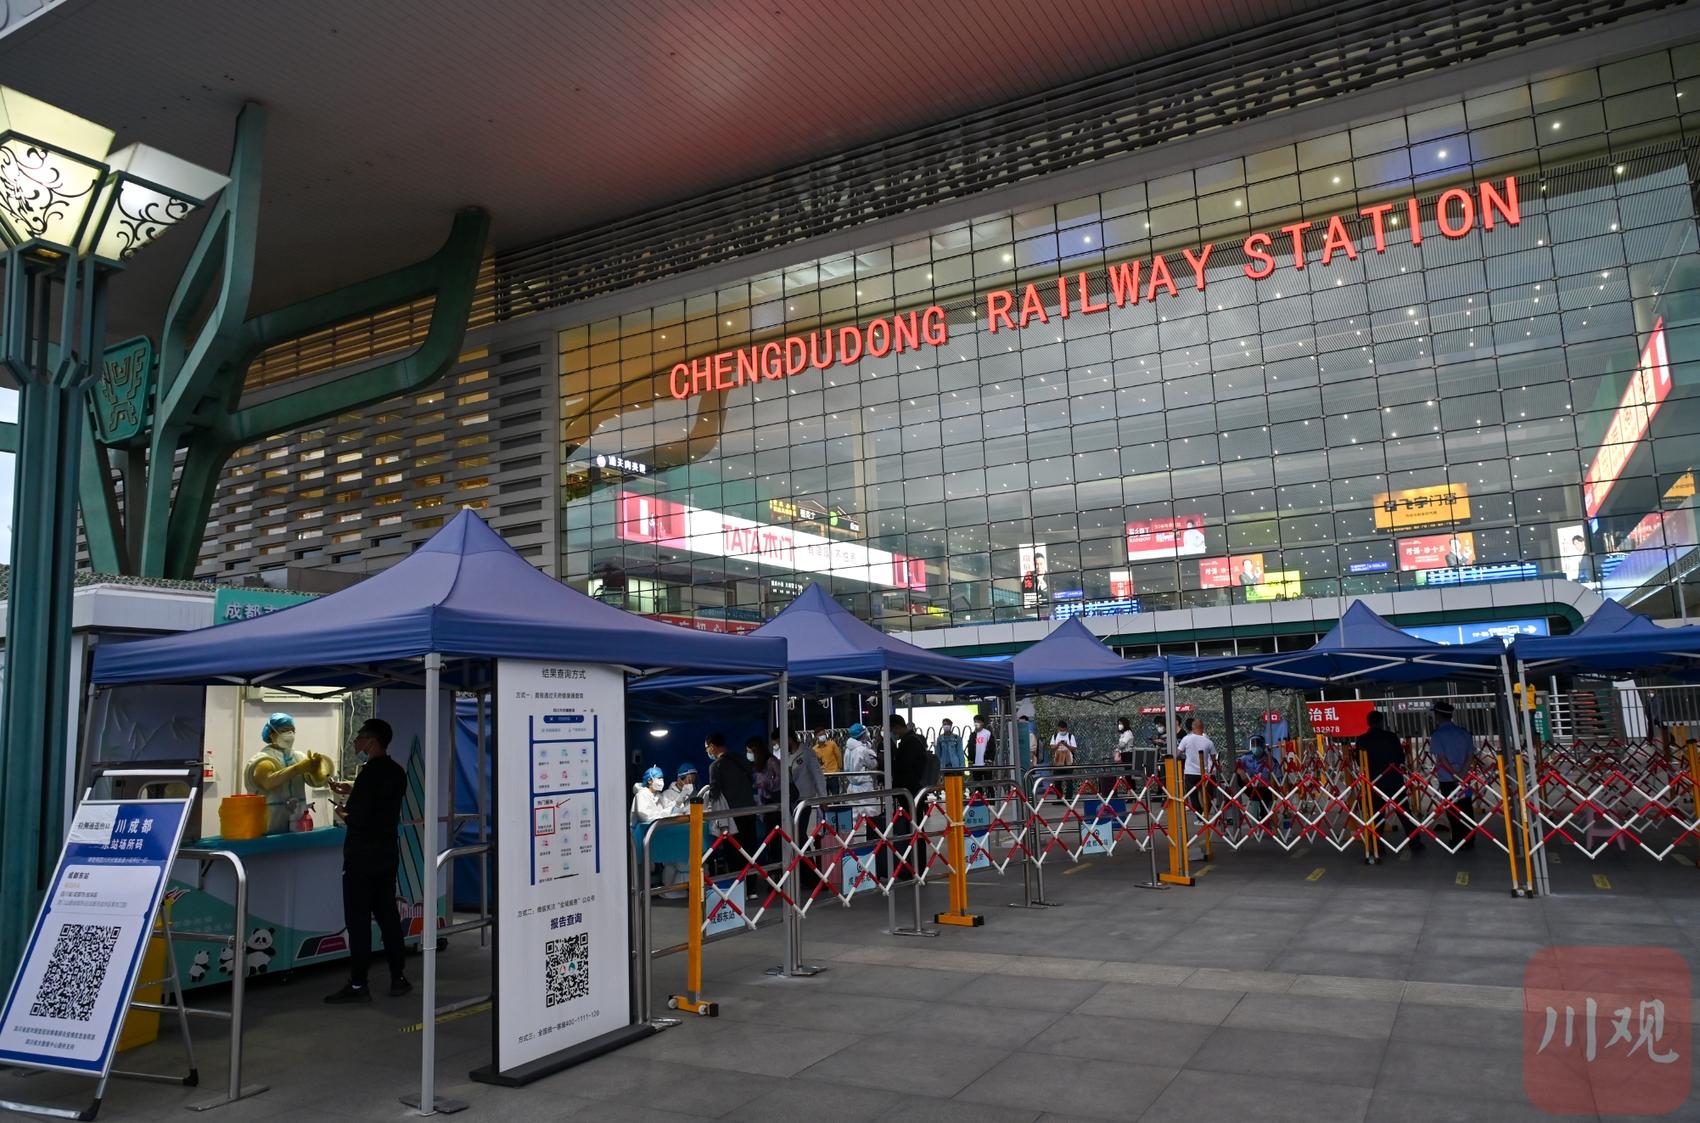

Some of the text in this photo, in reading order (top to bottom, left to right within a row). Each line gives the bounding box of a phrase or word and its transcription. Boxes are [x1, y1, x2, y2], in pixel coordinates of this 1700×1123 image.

[669, 175, 1520, 399] CHENGDUDONG RAILWAY STATION
[721, 524, 793, 562] TATA木门
[541, 667, 587, 680] 结果查询方式
[1308, 707, 1340, 722] 治乱
[550, 913, 583, 930] 报告查询
